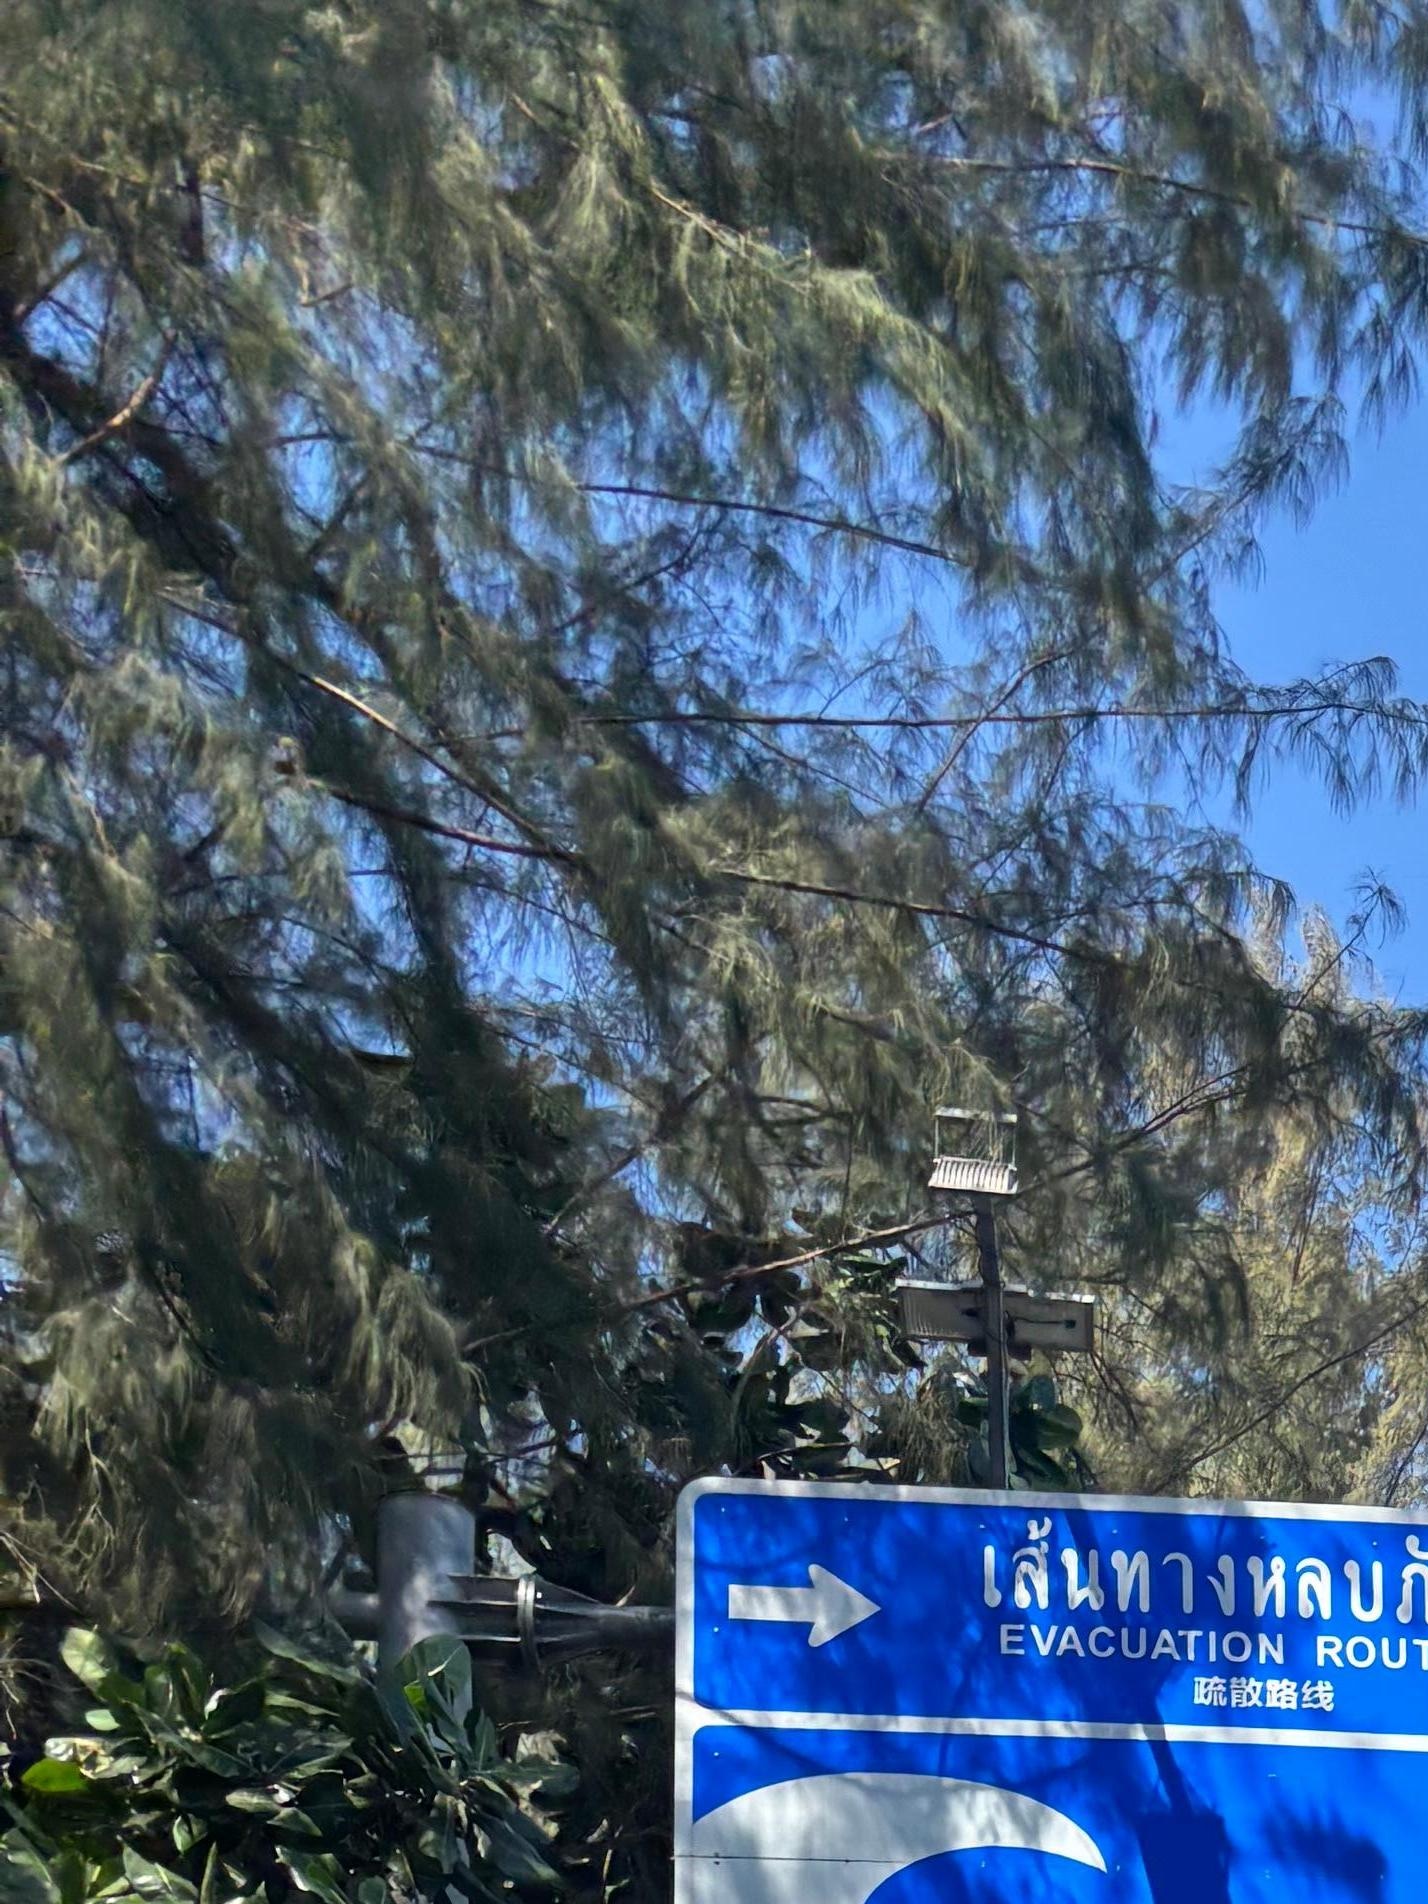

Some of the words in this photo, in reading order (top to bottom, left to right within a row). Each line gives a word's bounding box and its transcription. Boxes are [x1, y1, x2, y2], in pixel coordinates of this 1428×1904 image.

[999, 1623, 1286, 1665] EVACUATION
[1193, 1675, 1336, 1712] 疏散路线
